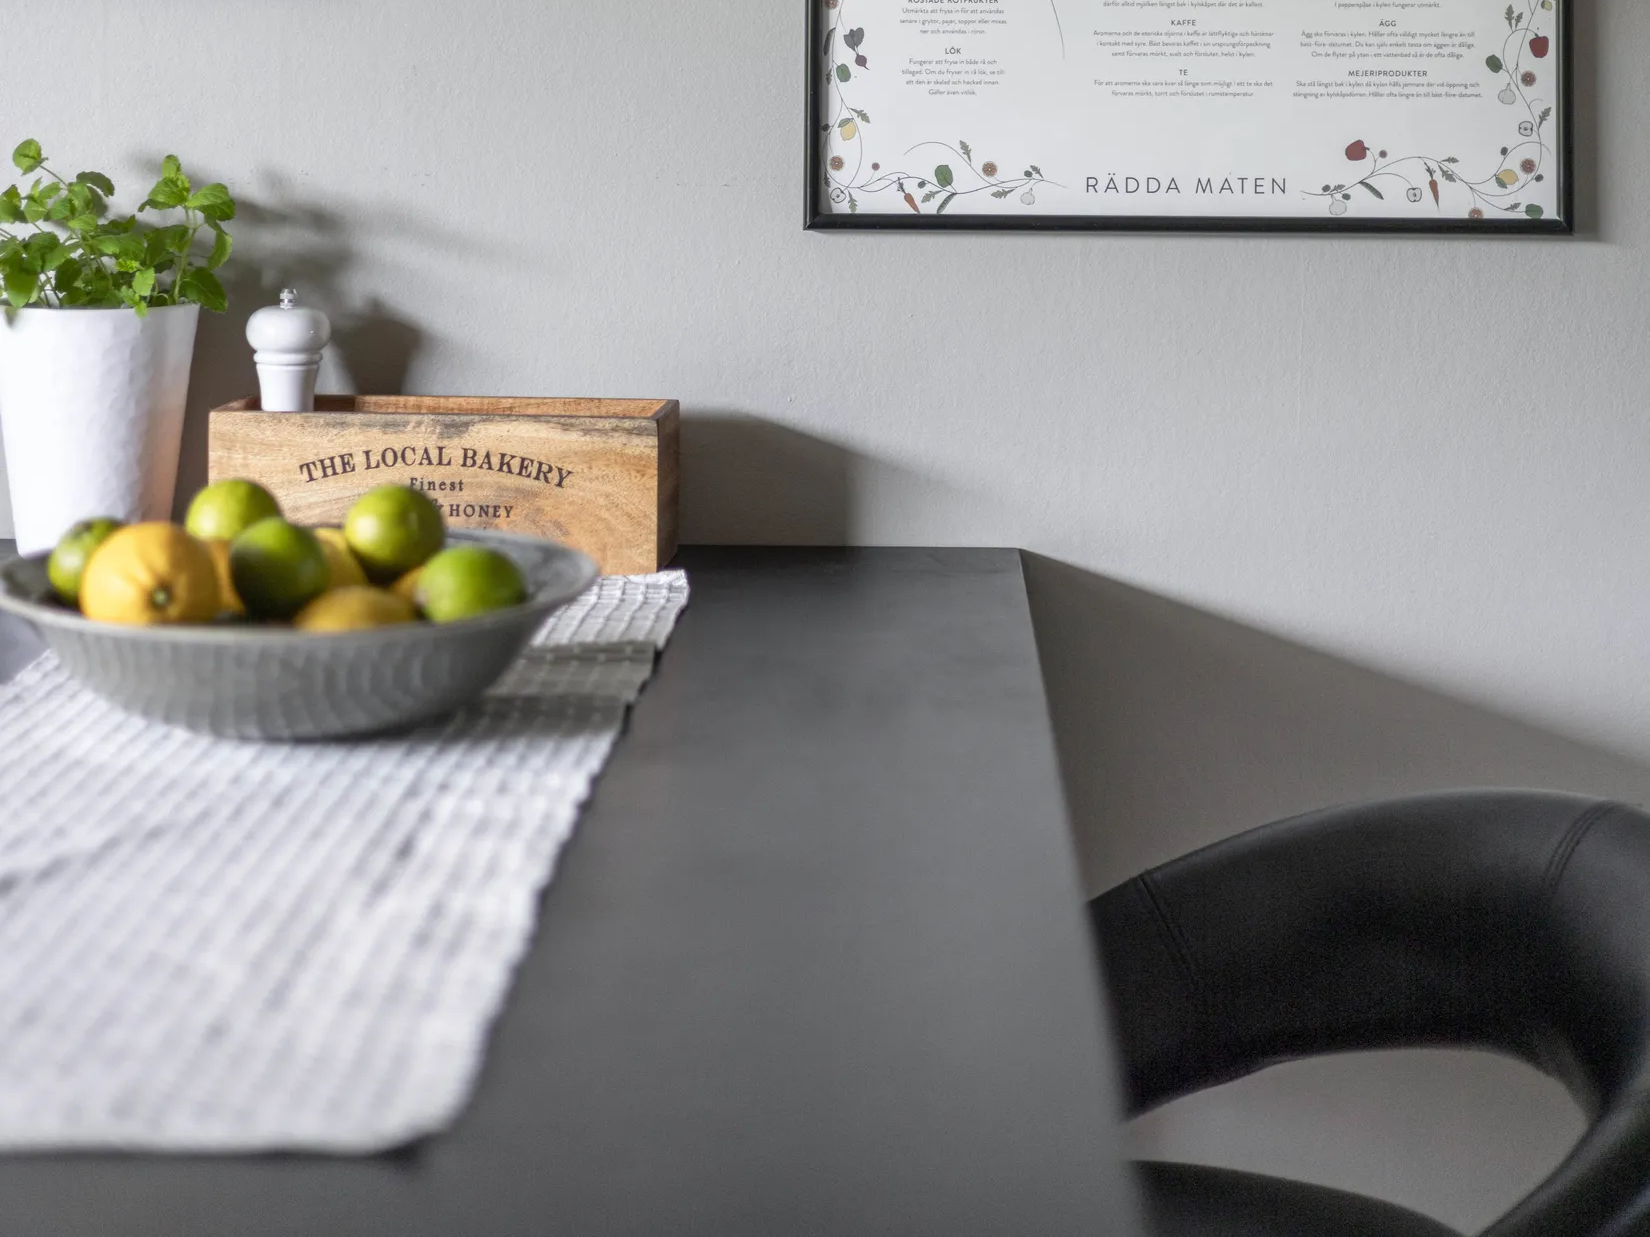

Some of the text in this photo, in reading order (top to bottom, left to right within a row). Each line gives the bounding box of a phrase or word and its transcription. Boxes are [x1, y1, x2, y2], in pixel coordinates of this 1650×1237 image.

[1378, 19, 1397, 27] ÄGG
[945, 46, 961, 55] LÖK
[1086, 172, 1181, 194] RÄDDA
[299, 445, 574, 489] THE LOCAL BAKERY
[409, 477, 464, 492] Finest
[448, 503, 514, 519] HONEY
